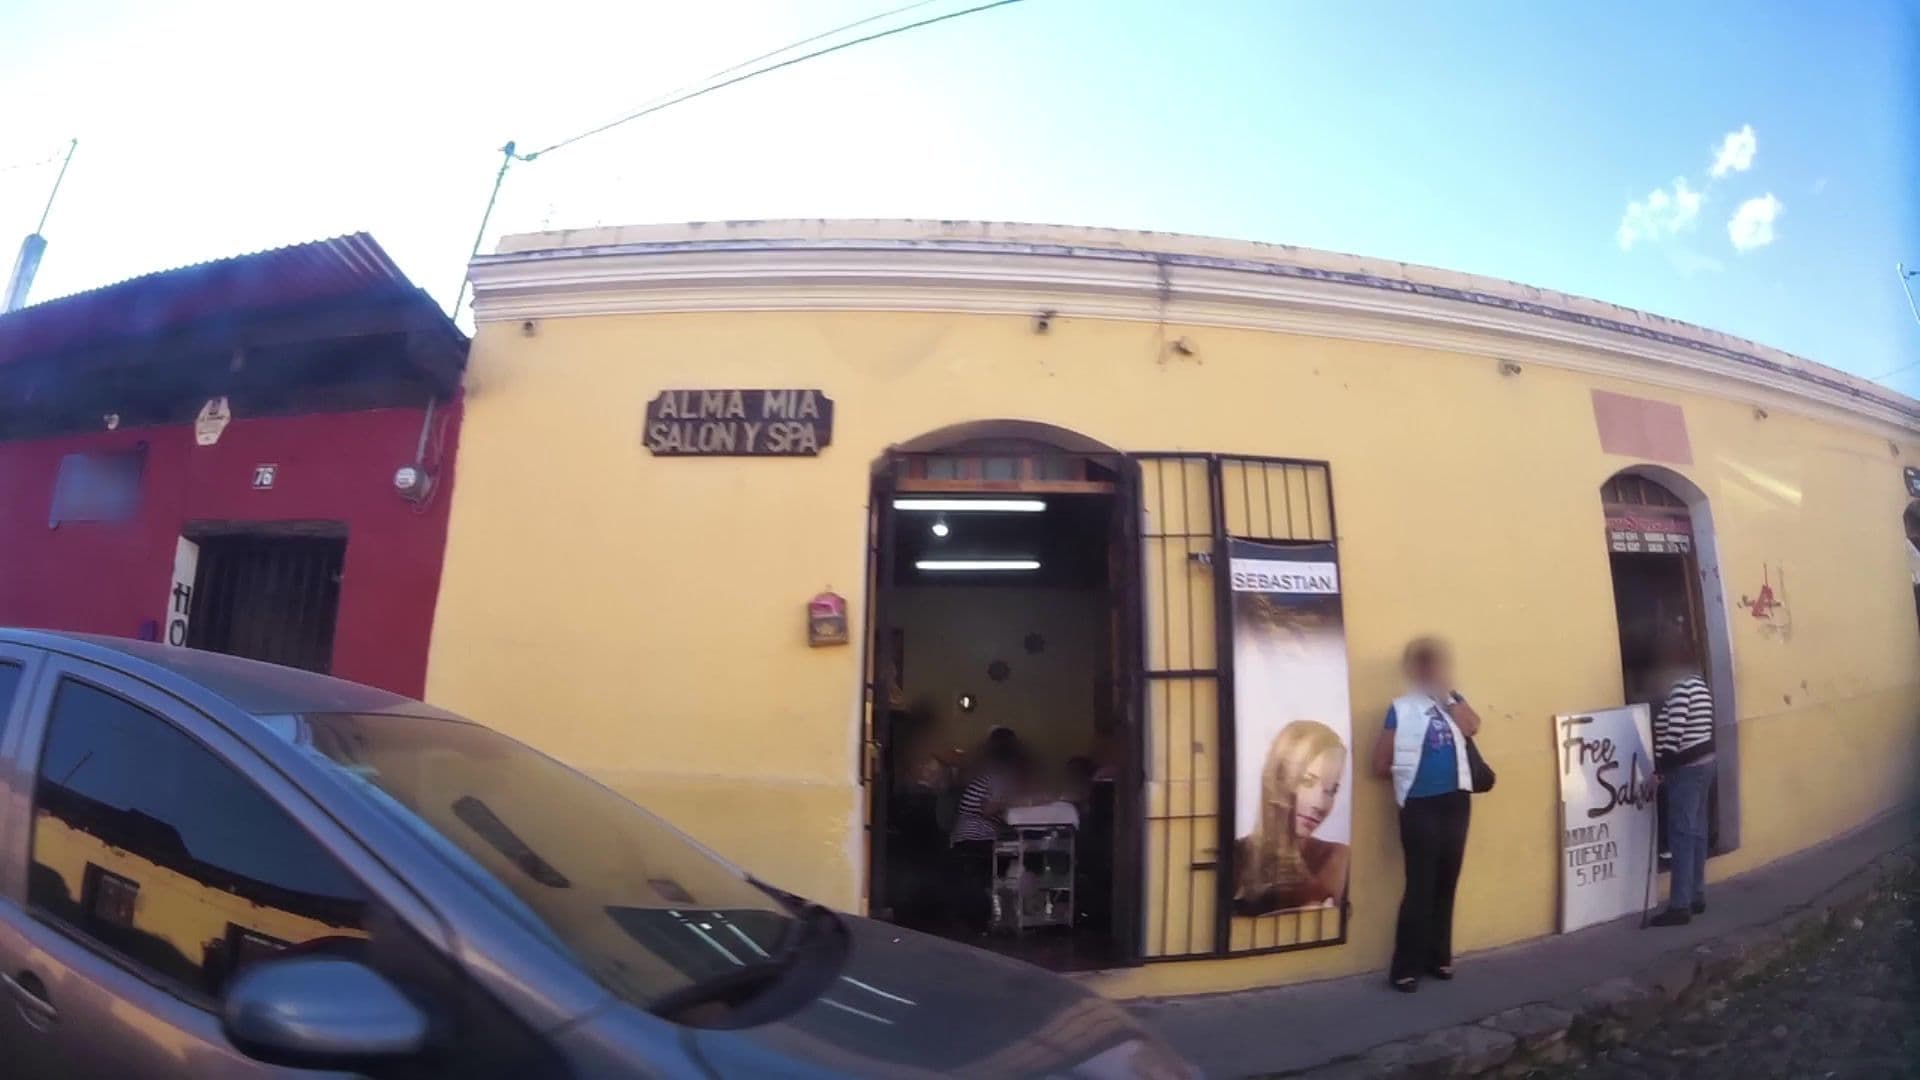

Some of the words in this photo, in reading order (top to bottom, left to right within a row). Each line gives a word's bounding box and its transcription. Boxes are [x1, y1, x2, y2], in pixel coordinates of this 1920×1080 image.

[657, 390, 745, 419] ALMA
[762, 390, 819, 419] MIA
[649, 420, 736, 453] SALON
[743, 420, 762, 453] Y
[766, 421, 818, 453] SPA
[1233, 572, 1333, 591] SEBASTIAN
[1561, 715, 1616, 775] Free
